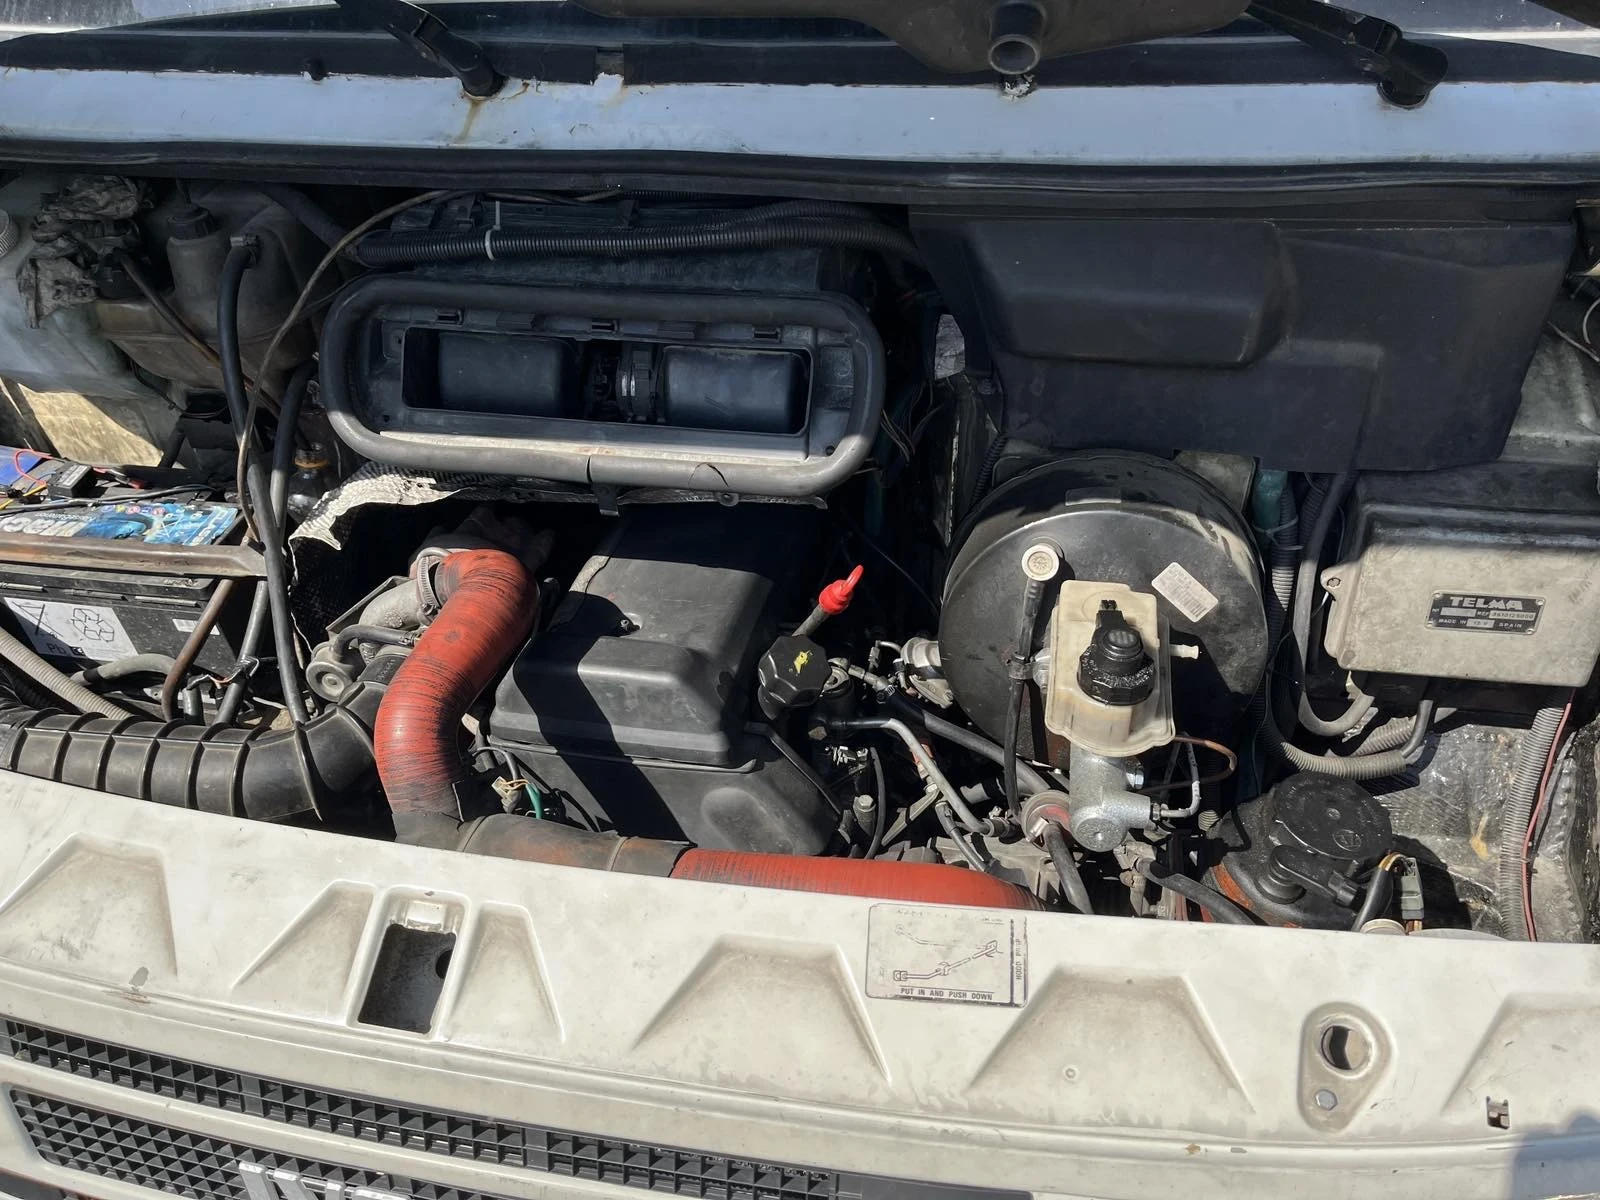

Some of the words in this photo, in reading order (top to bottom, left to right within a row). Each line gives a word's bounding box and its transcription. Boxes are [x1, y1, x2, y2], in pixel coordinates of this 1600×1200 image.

[1450, 596, 1523, 610] TELMA
[900, 987, 914, 996] PUT
[918, 988, 926, 996] IN
[929, 990, 944, 998] AND
[948, 991, 967, 999] PUSH
[971, 992, 993, 1001] DOWN
